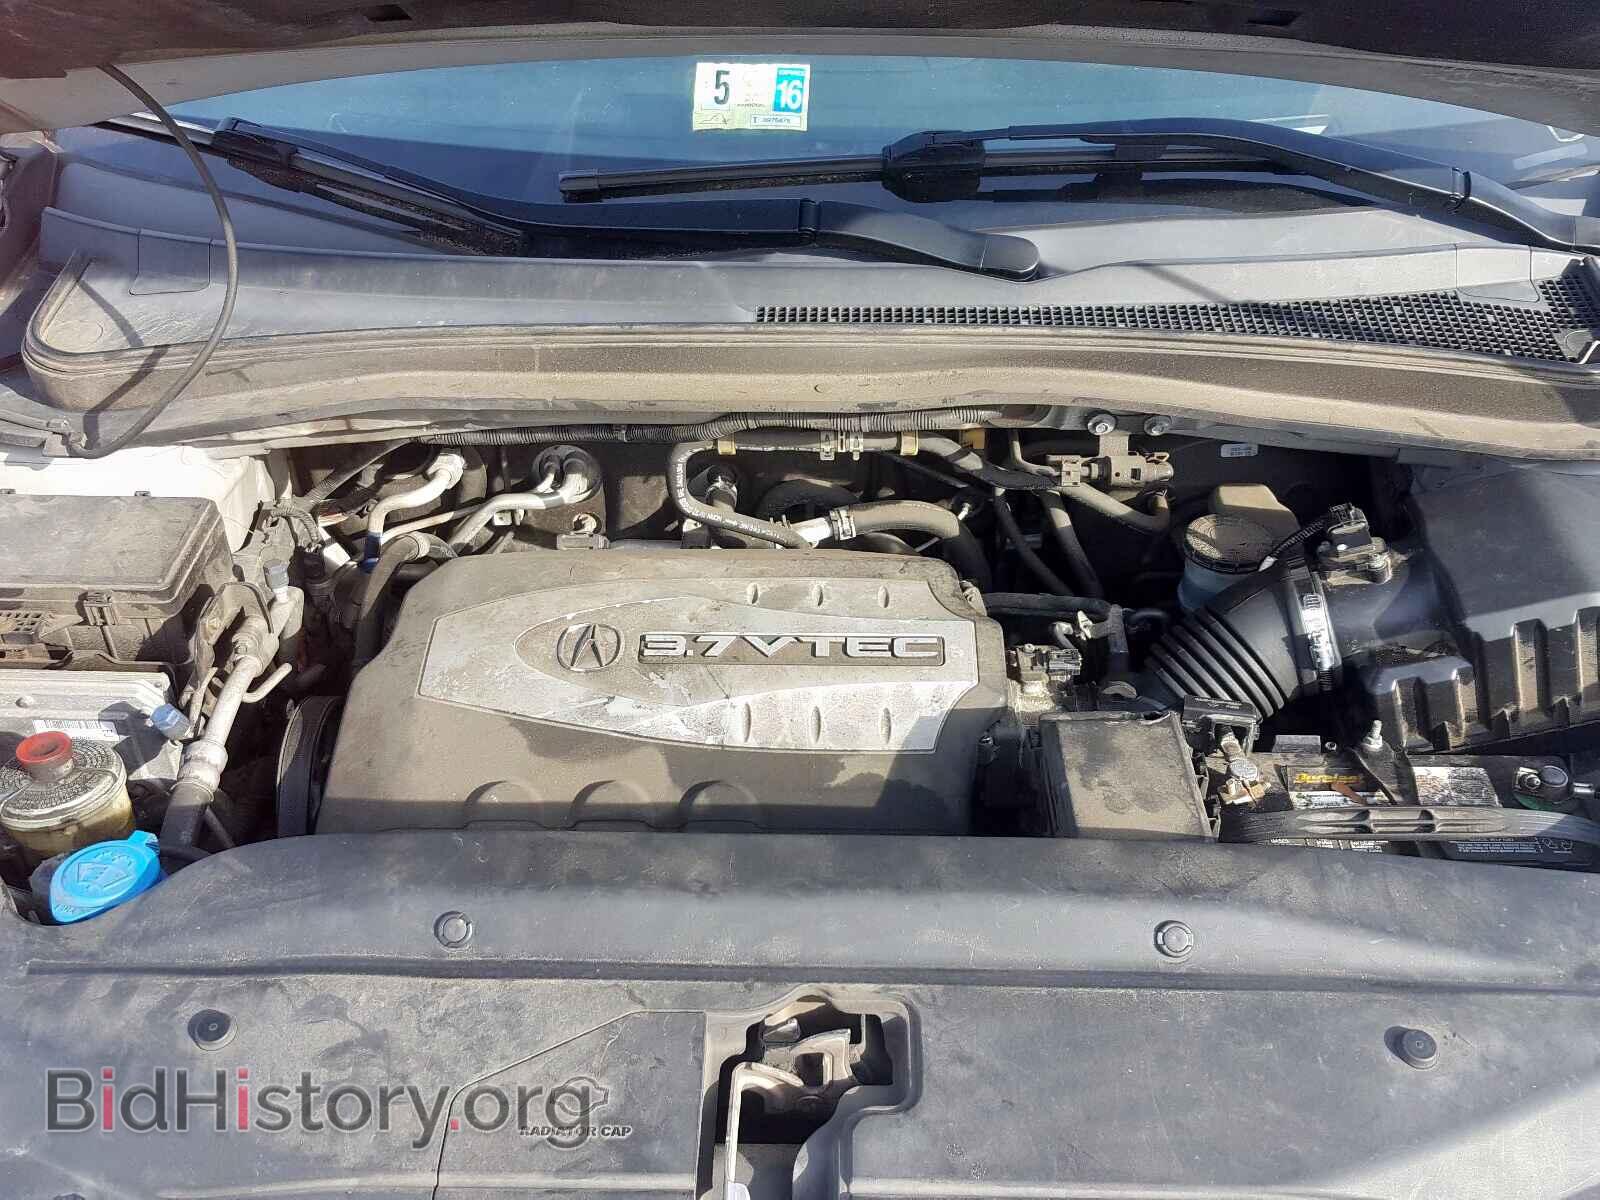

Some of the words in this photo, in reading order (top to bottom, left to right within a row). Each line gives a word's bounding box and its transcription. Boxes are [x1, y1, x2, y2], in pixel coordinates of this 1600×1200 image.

[714, 70, 730, 105] 5
[777, 79, 803, 110] 16
[519, 1126, 597, 1137] RADIATOR
[600, 1126, 632, 1137] CAP
